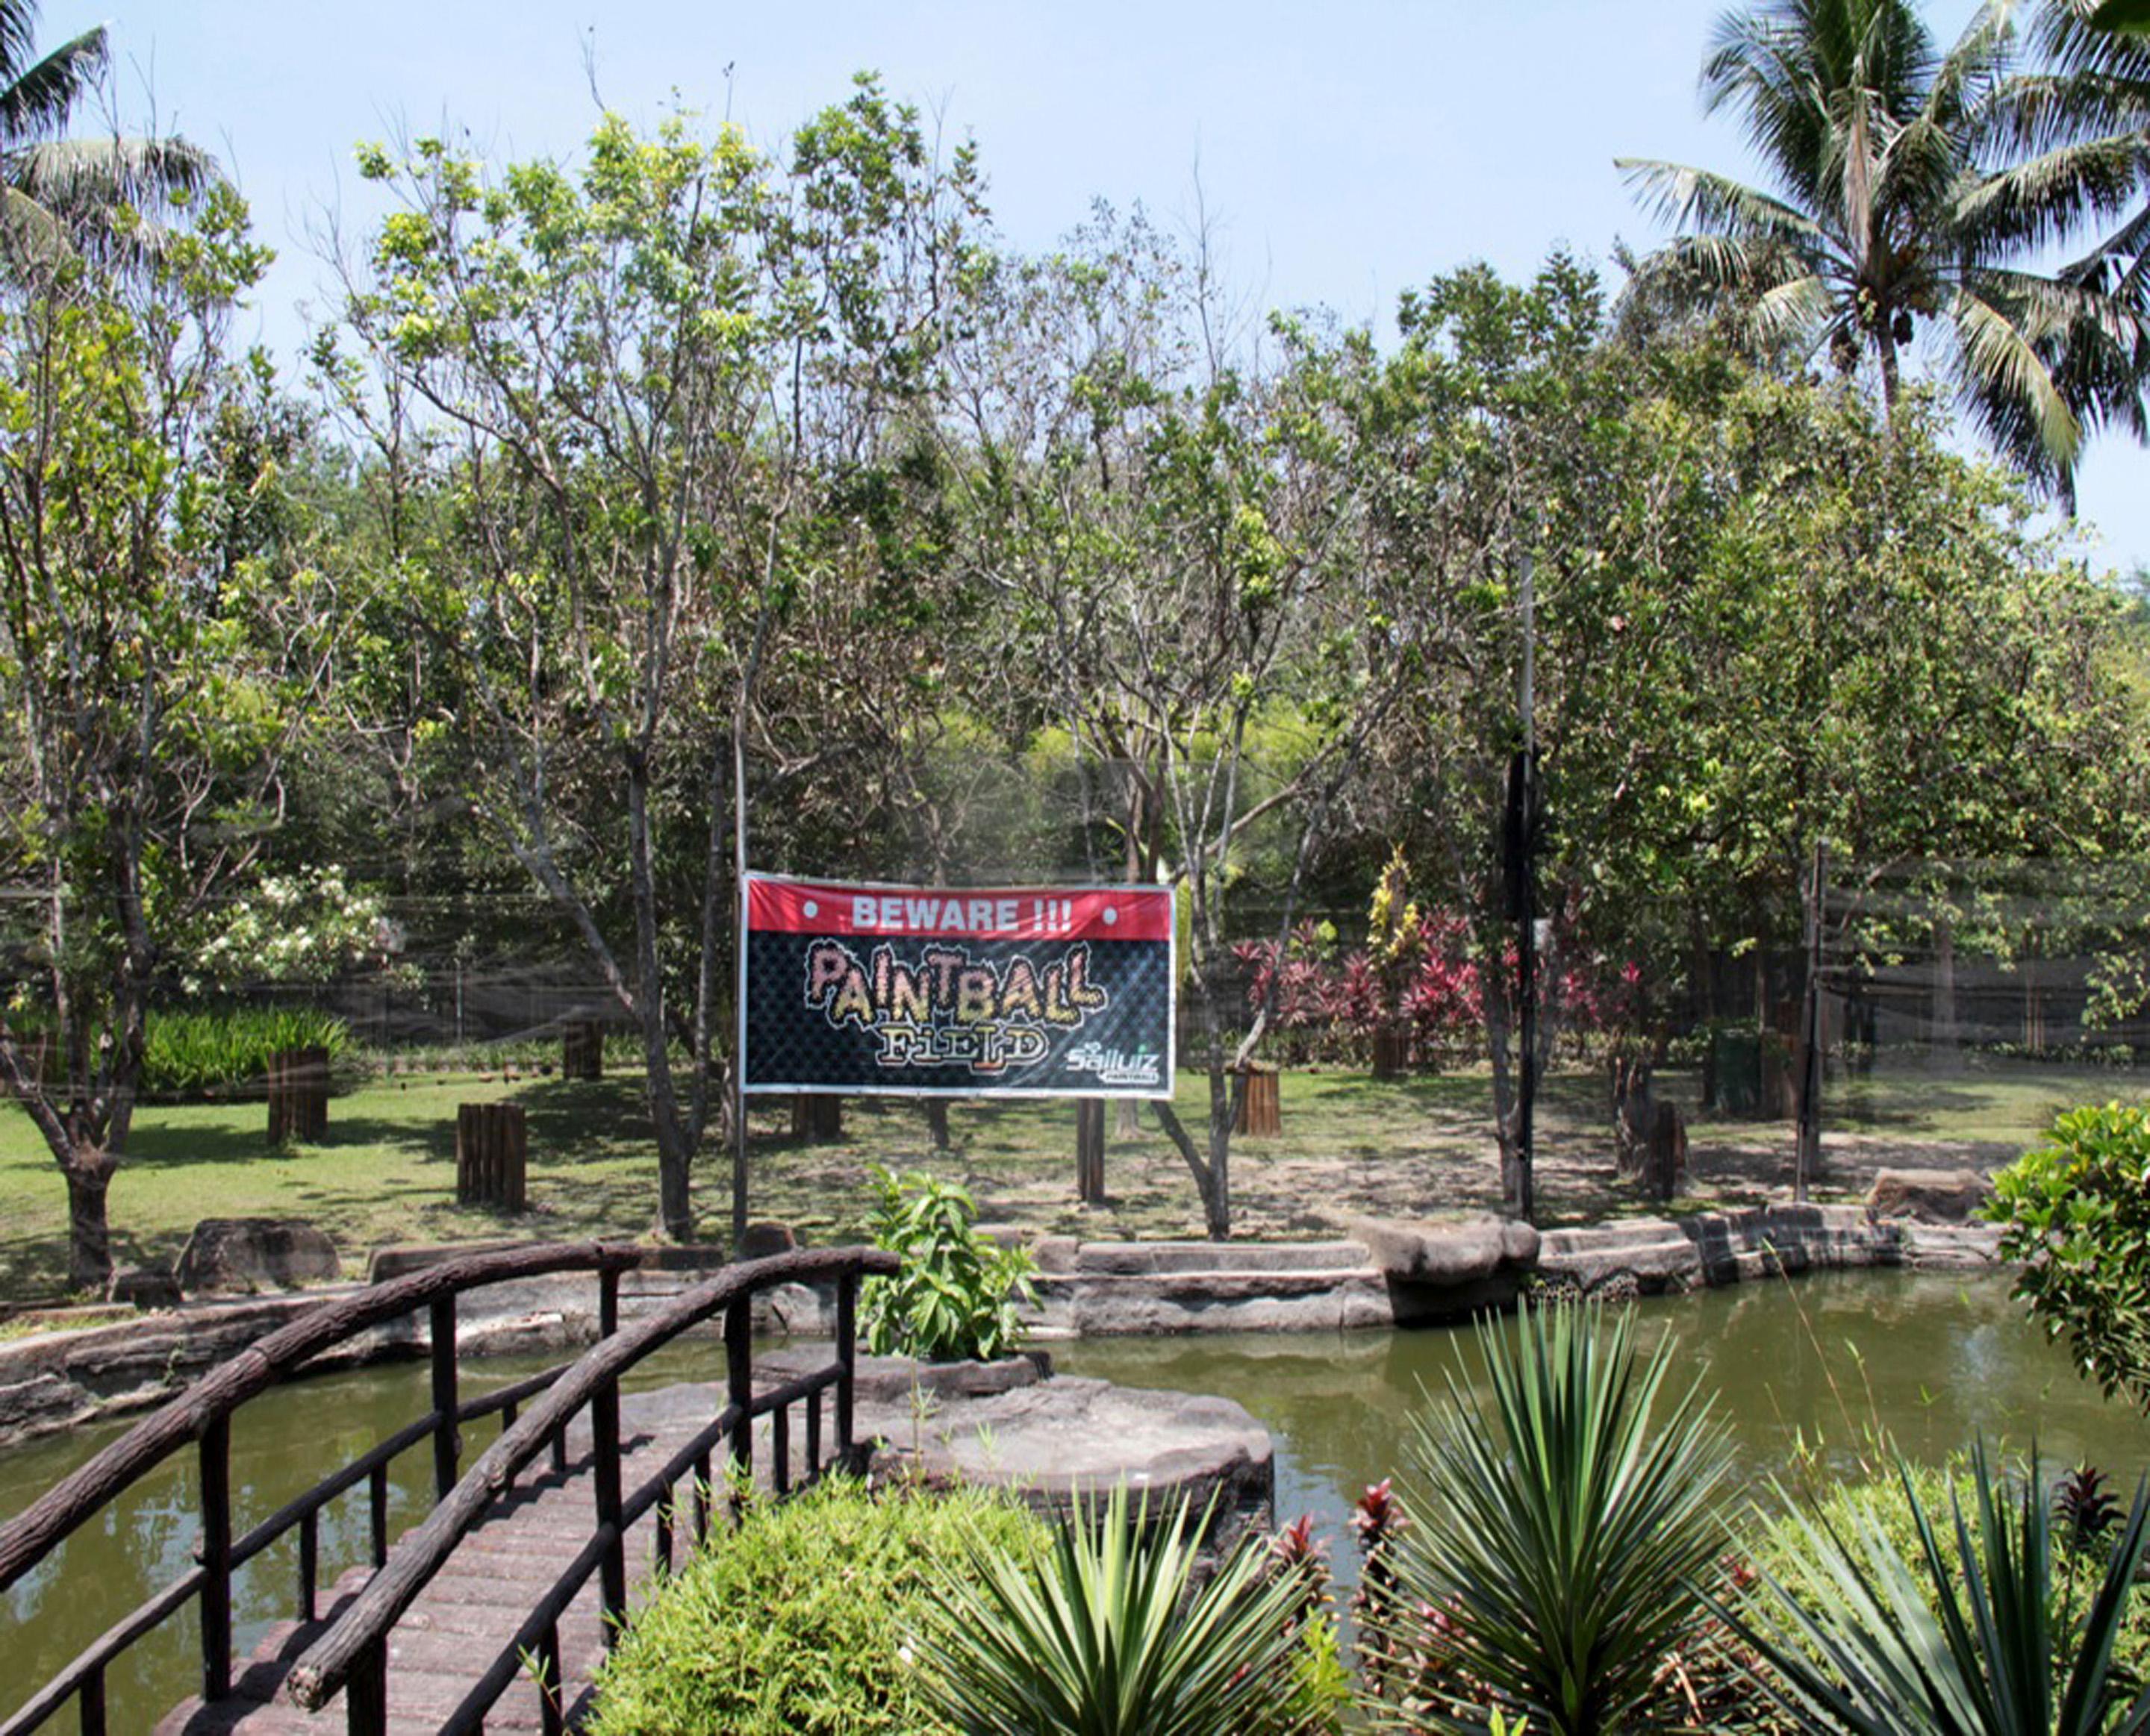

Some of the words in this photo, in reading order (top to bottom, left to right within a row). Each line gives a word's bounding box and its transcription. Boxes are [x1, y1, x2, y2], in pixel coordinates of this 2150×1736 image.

[853, 896, 1020, 931] BEWARE
[1034, 899, 1072, 932] !!!
[807, 941, 1106, 1027] PAINTBALL
